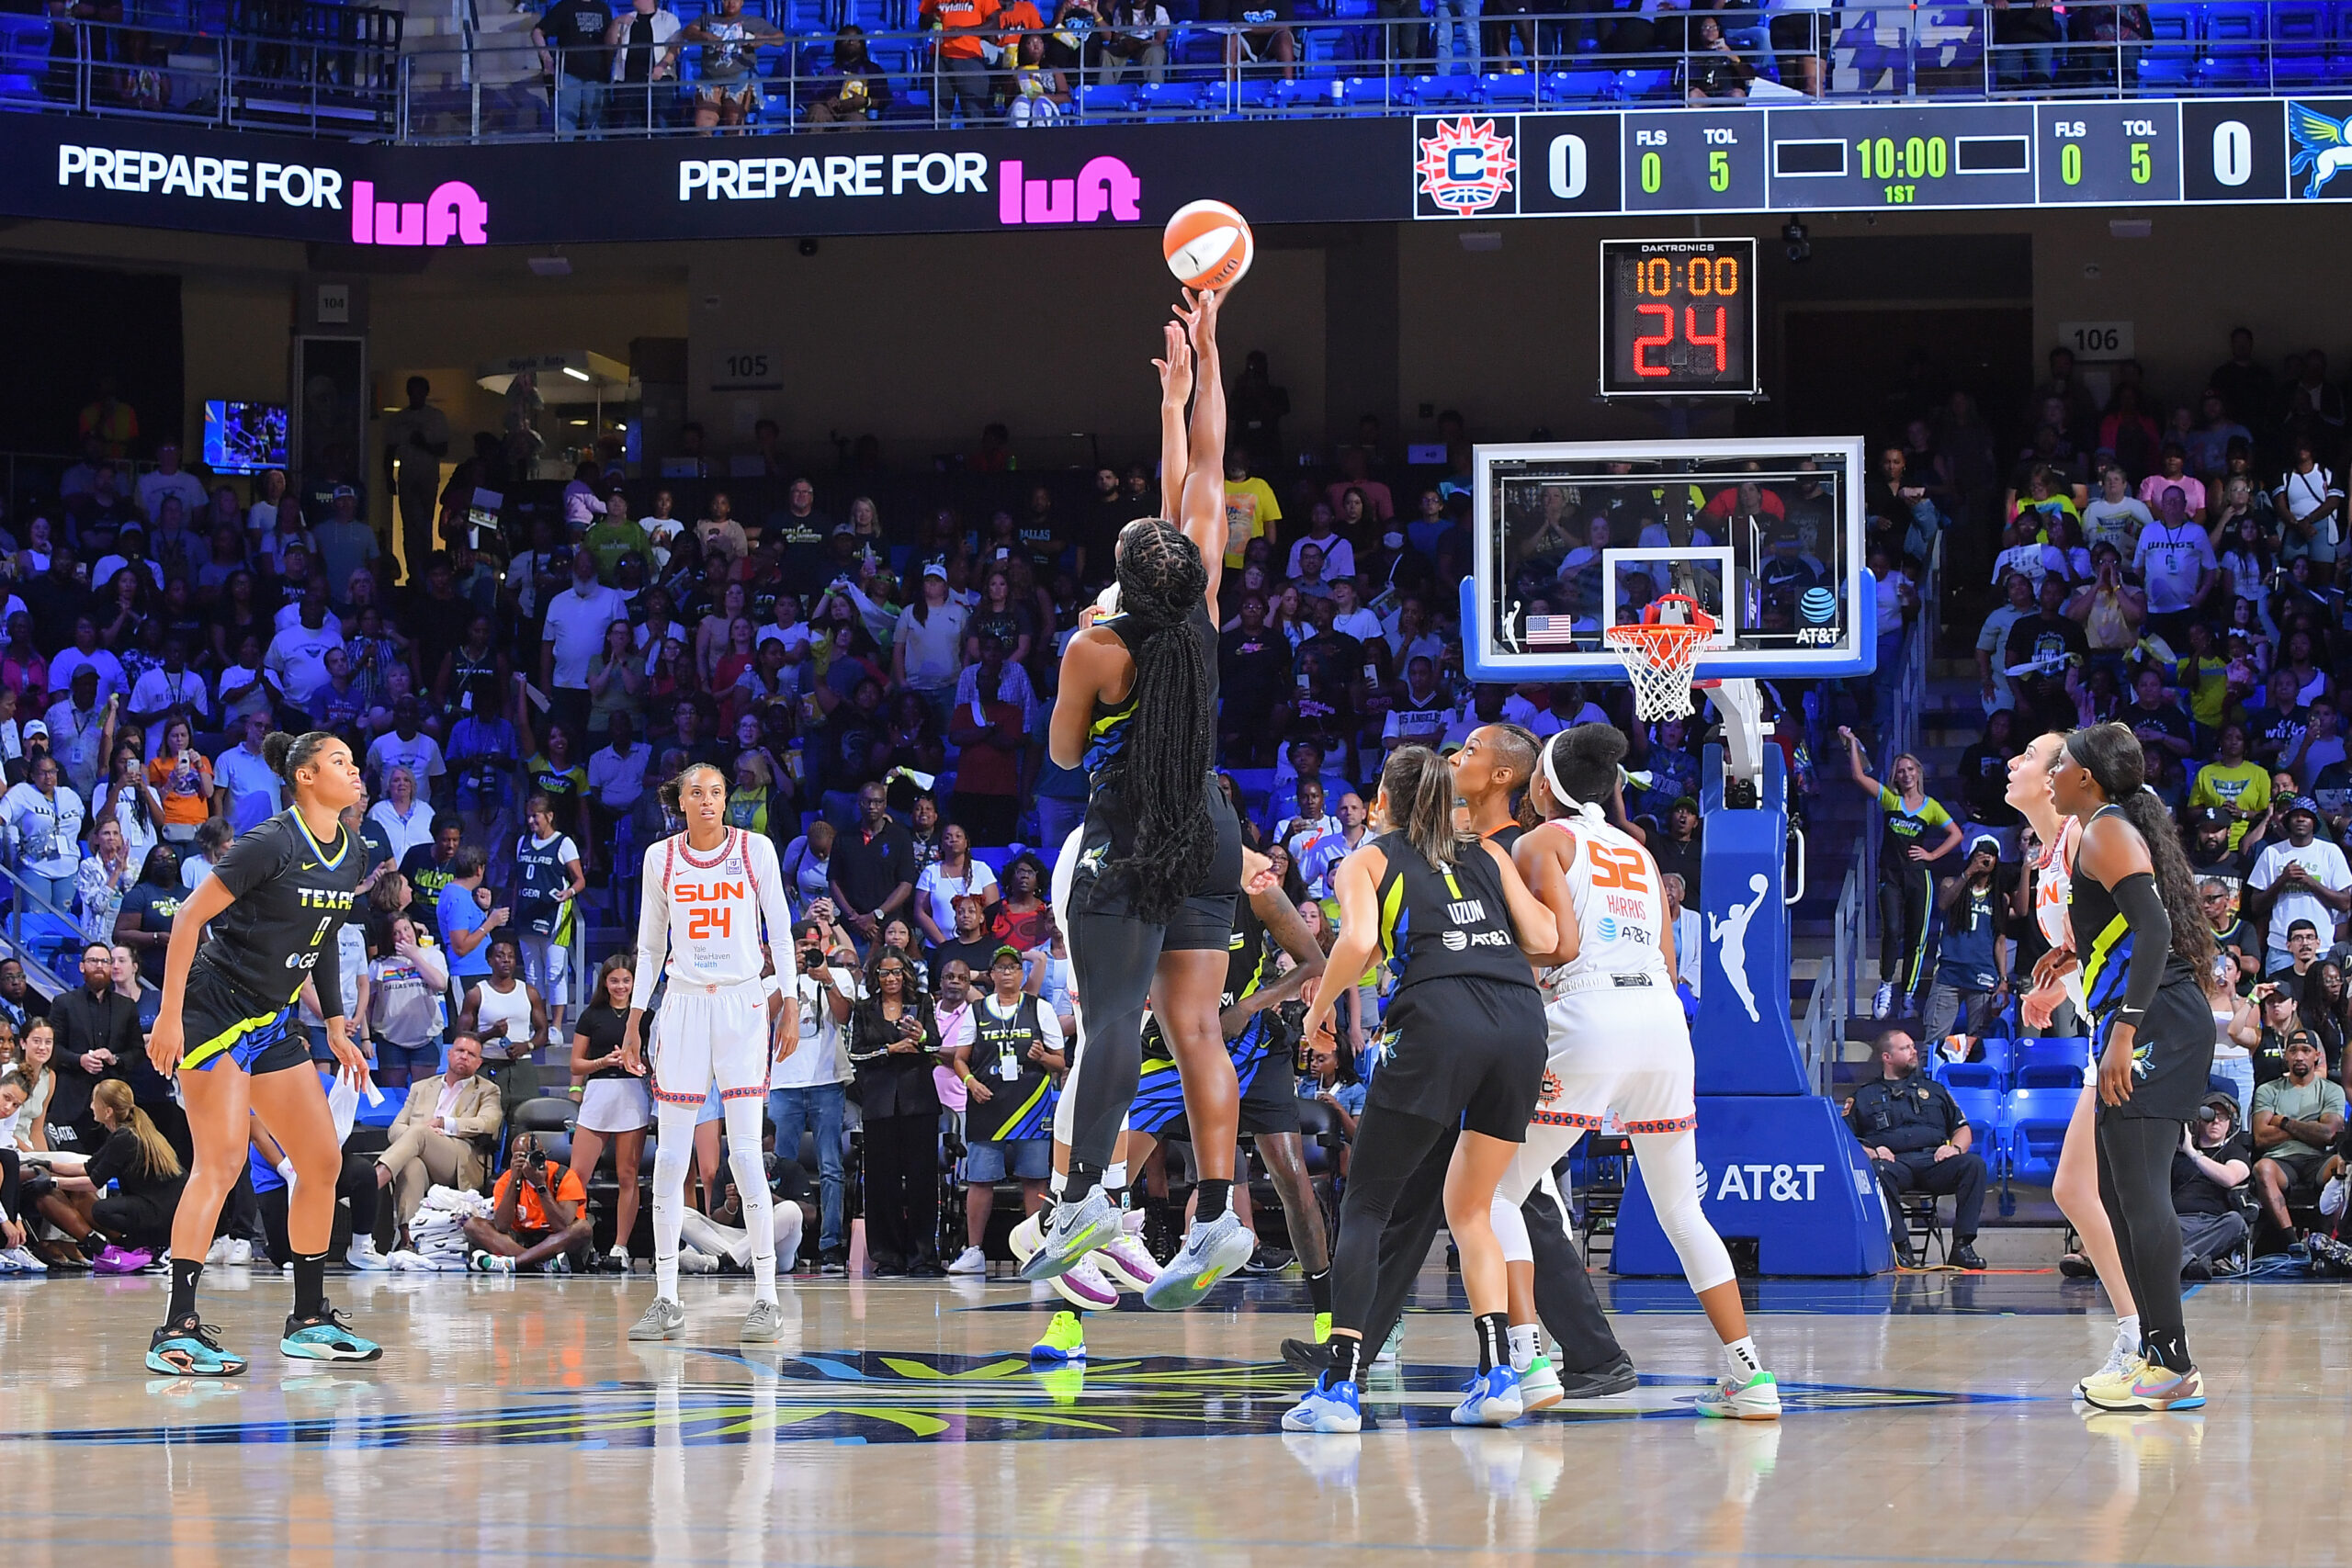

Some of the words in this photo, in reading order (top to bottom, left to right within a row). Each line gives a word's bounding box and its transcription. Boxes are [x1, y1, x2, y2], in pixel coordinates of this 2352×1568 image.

[1636, 129, 1668, 146] FLS
[1703, 128, 1737, 145] TOL
[2054, 120, 2086, 138] FLS
[2122, 119, 2157, 137] TOL
[1856, 136, 1947, 179] 10:00
[2131, 142, 2151, 184] 5
[2212, 120, 2252, 186] 0
[1548, 134, 1588, 198] 0
[1640, 152, 1662, 194] 0
[1709, 151, 1730, 192] 5
[2061, 143, 2082, 186] 0
[58, 143, 249, 201] PREPARE
[256, 163, 343, 210] FOR
[679, 154, 884, 201] PREPARE
[891, 152, 988, 195] FOR
[1884, 185, 1916, 204] 1ST
[1641, 243, 1715, 253] DAKTRONICS
[1636, 256, 1738, 297] 10:00
[323, 298, 345, 309] 104
[1633, 304, 1726, 377] 24
[2075, 329, 2119, 351] 106
[727, 355, 768, 377] 105
[2148, 540, 2196, 550] WINGS
[1795, 627, 1841, 644] AT&T
[35, 806, 80, 820] WIGS
[526, 863, 536, 880] 0
[1587, 840, 1648, 895] 52
[674, 882, 744, 903] SUN
[1447, 899, 1487, 925] UZUN
[1606, 895, 1646, 920] HARRIS
[310, 916, 333, 947] 0
[688, 908, 731, 940] 24
[1471, 931, 1511, 947] AT&T
[1621, 926, 1652, 947] AT&T
[694, 945, 707, 953] Yale
[695, 961, 718, 969] Health
[384, 982, 408, 992] DALLAS
[981, 1028, 1032, 1041] TEXAS
[1716, 1164, 1825, 1201] AT&T
